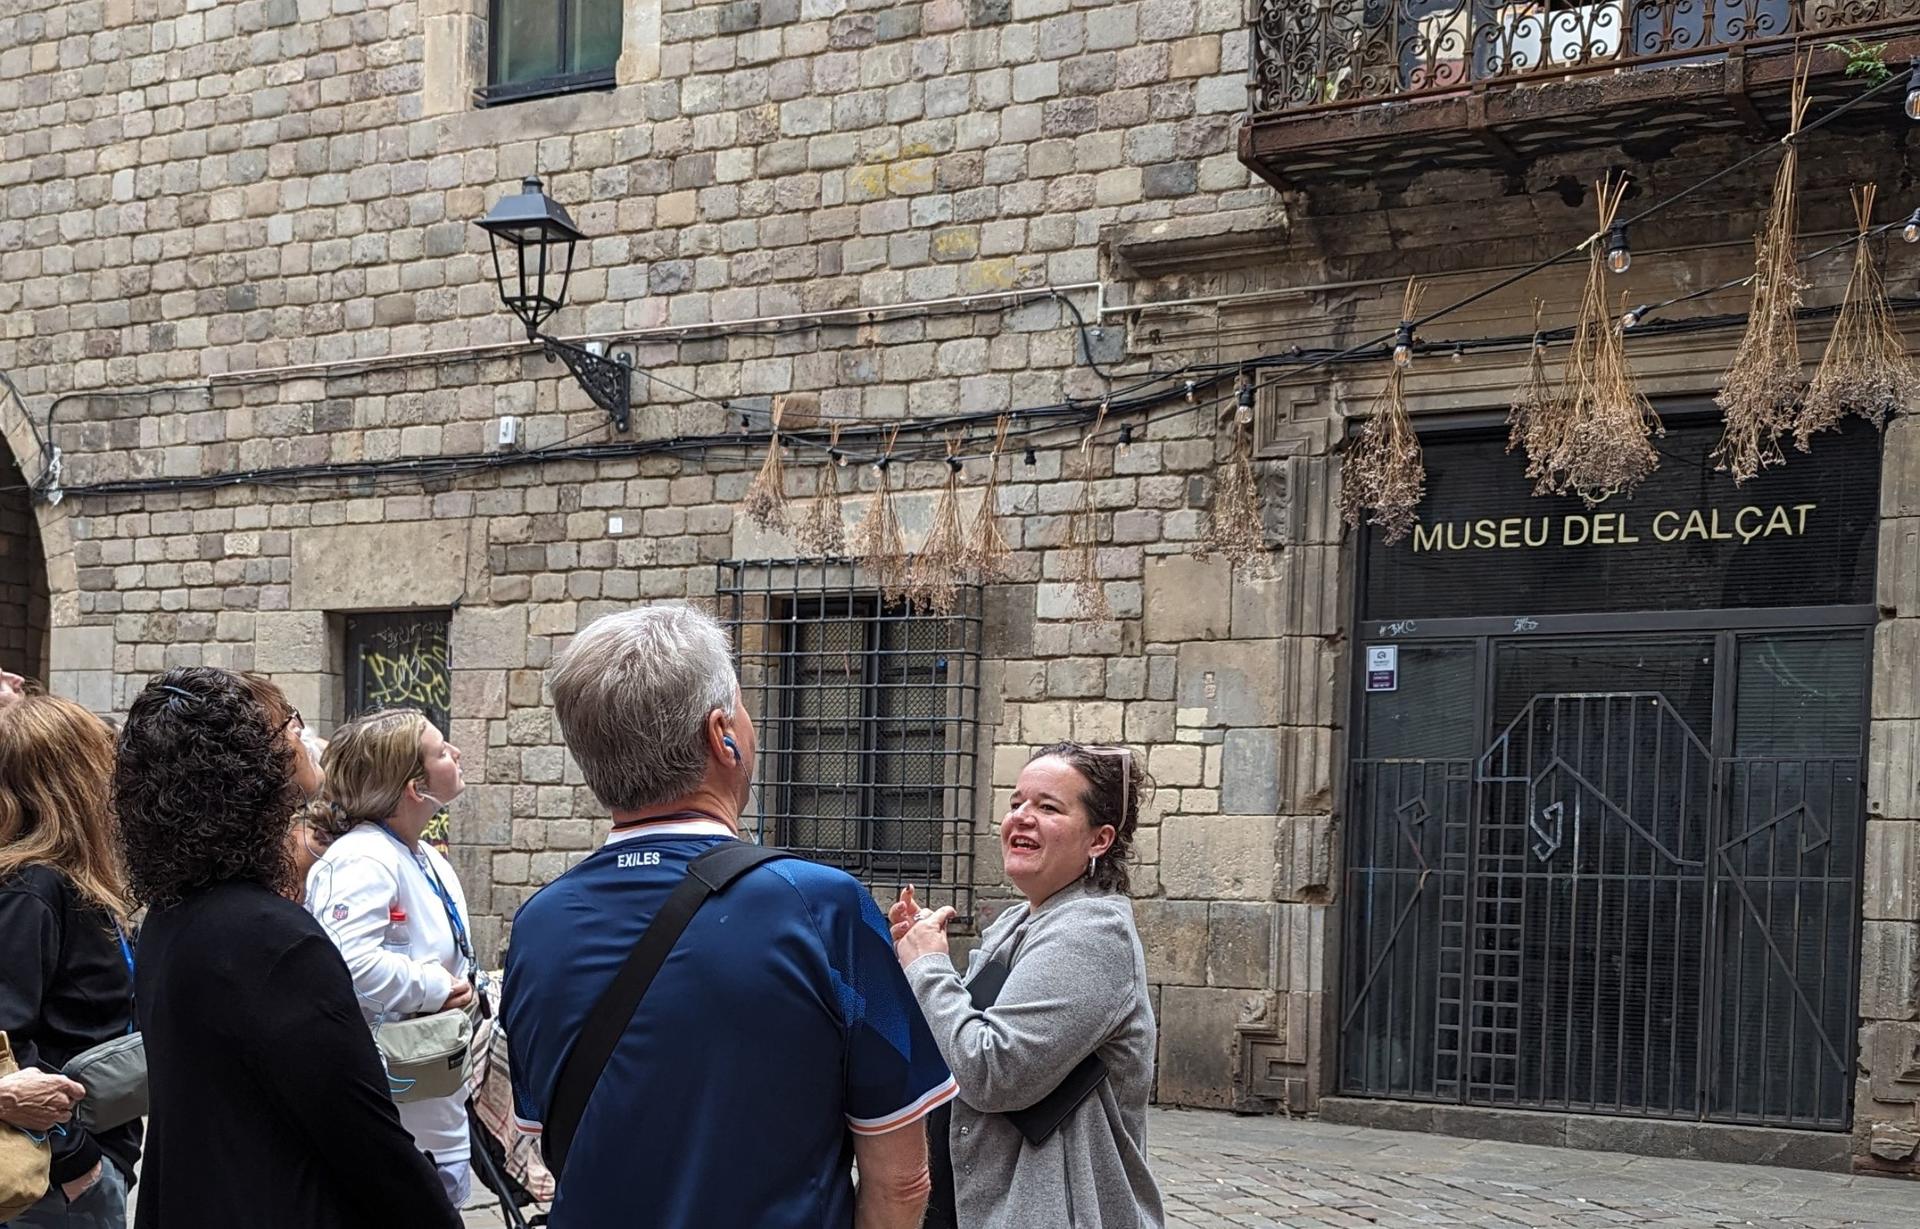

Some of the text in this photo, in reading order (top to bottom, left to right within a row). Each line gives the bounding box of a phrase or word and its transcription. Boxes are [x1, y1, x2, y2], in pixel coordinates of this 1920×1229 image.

[1412, 503, 1818, 552] MUSEU DEL CALÇAT
[617, 851, 661, 868] EXILES
